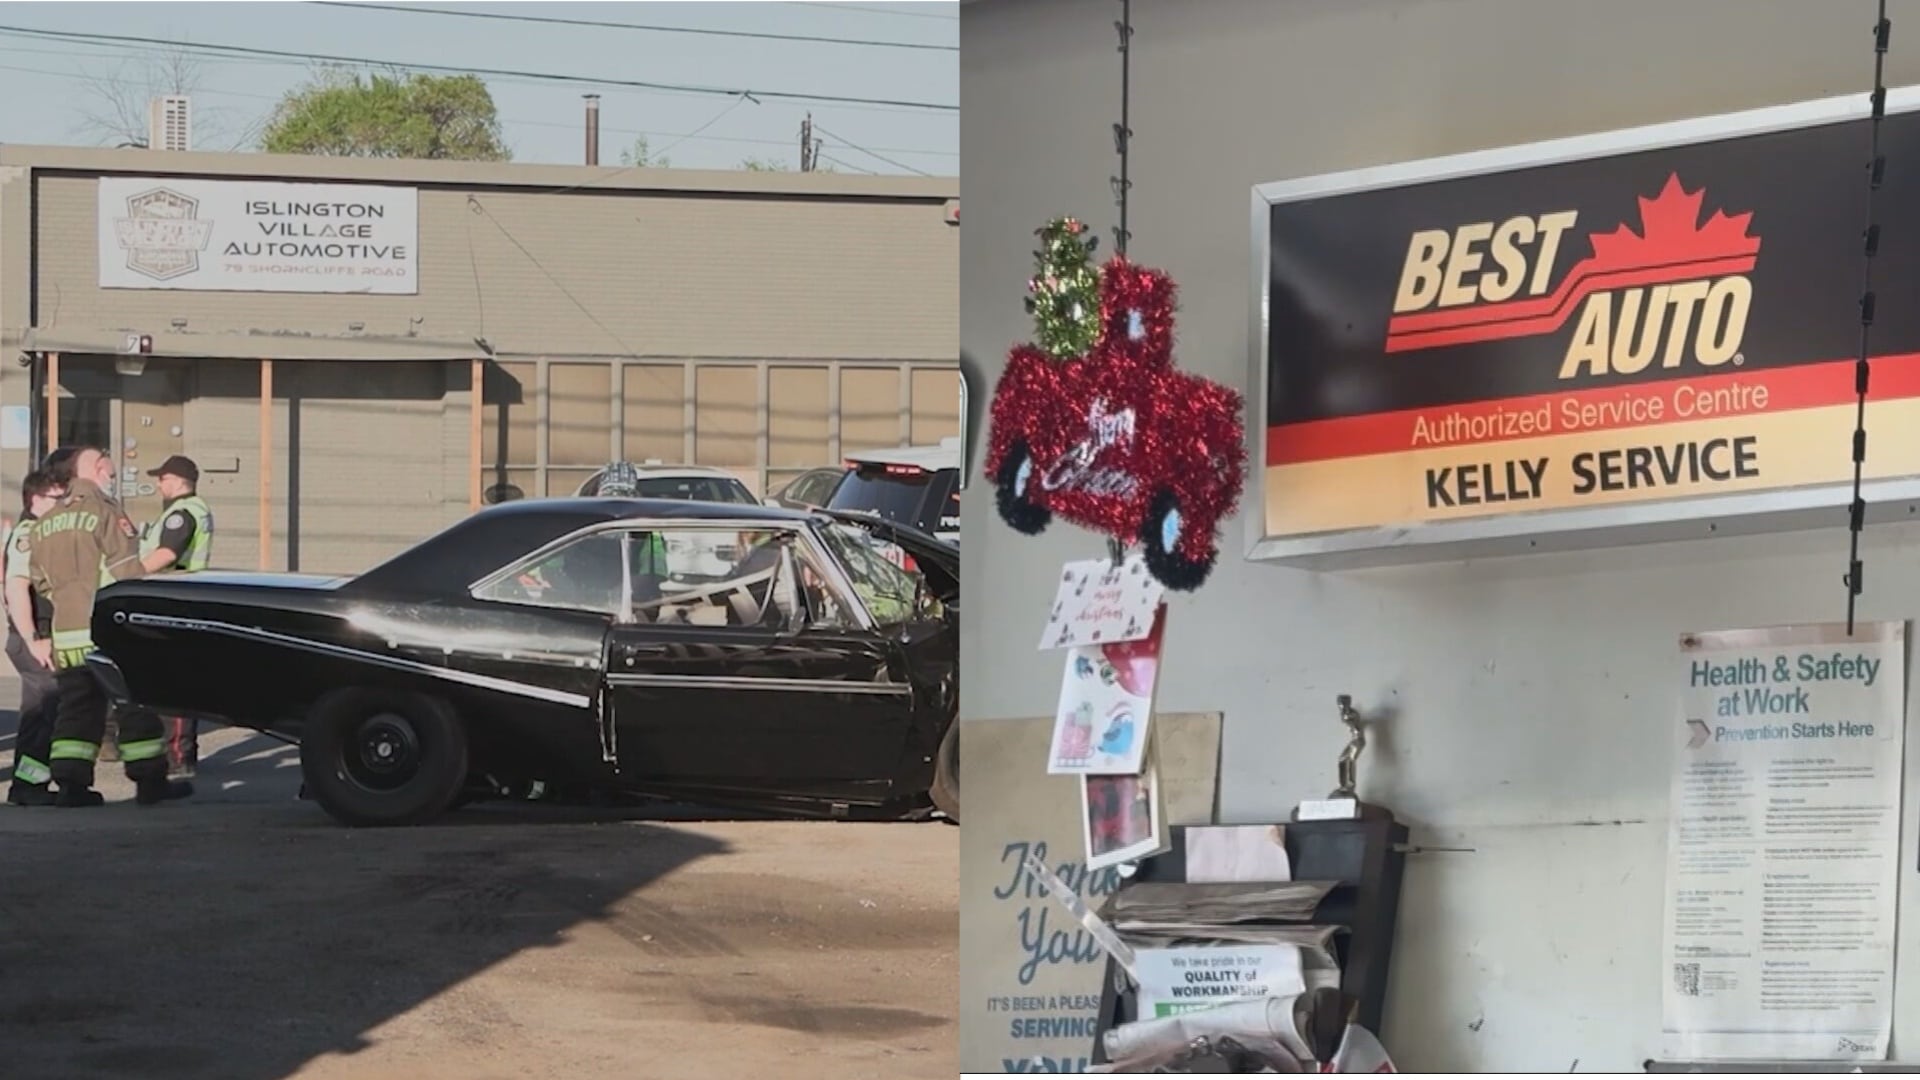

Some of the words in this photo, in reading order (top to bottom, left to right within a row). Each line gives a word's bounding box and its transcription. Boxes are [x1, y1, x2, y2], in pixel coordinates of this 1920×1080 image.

[245, 201, 384, 219] ISLINGTON
[258, 222, 372, 238] VILLAGE
[223, 241, 407, 260] AUTOMOTIVE
[1393, 209, 1579, 314] BEST
[1558, 274, 1753, 380] AUTO
[1411, 402, 1552, 446] Authorized
[1561, 392, 1665, 431] Service
[1673, 382, 1769, 418] Centre
[1426, 457, 1550, 509] KELLY
[1571, 436, 1760, 495] SERVICE
[35, 511, 99, 542] TORONTO
[1690, 657, 1767, 688] Health
[1771, 655, 1791, 683] &
[1796, 652, 1881, 687] Safety
[1717, 691, 1740, 717] at
[1744, 686, 1810, 716] Work
[1715, 725, 1789, 743] Prevention
[1791, 722, 1836, 739] Starts
[1838, 720, 1875, 738] Here
[1018, 906, 1101, 986] You
[1171, 985, 1269, 998] WORKMANSHIP
[1184, 970, 1241, 983] QUALITY
[1244, 969, 1257, 981] of
[987, 996, 1010, 1012] IT'S
[1012, 996, 1045, 1011] BEEN
[1048, 996, 1058, 1010] A
